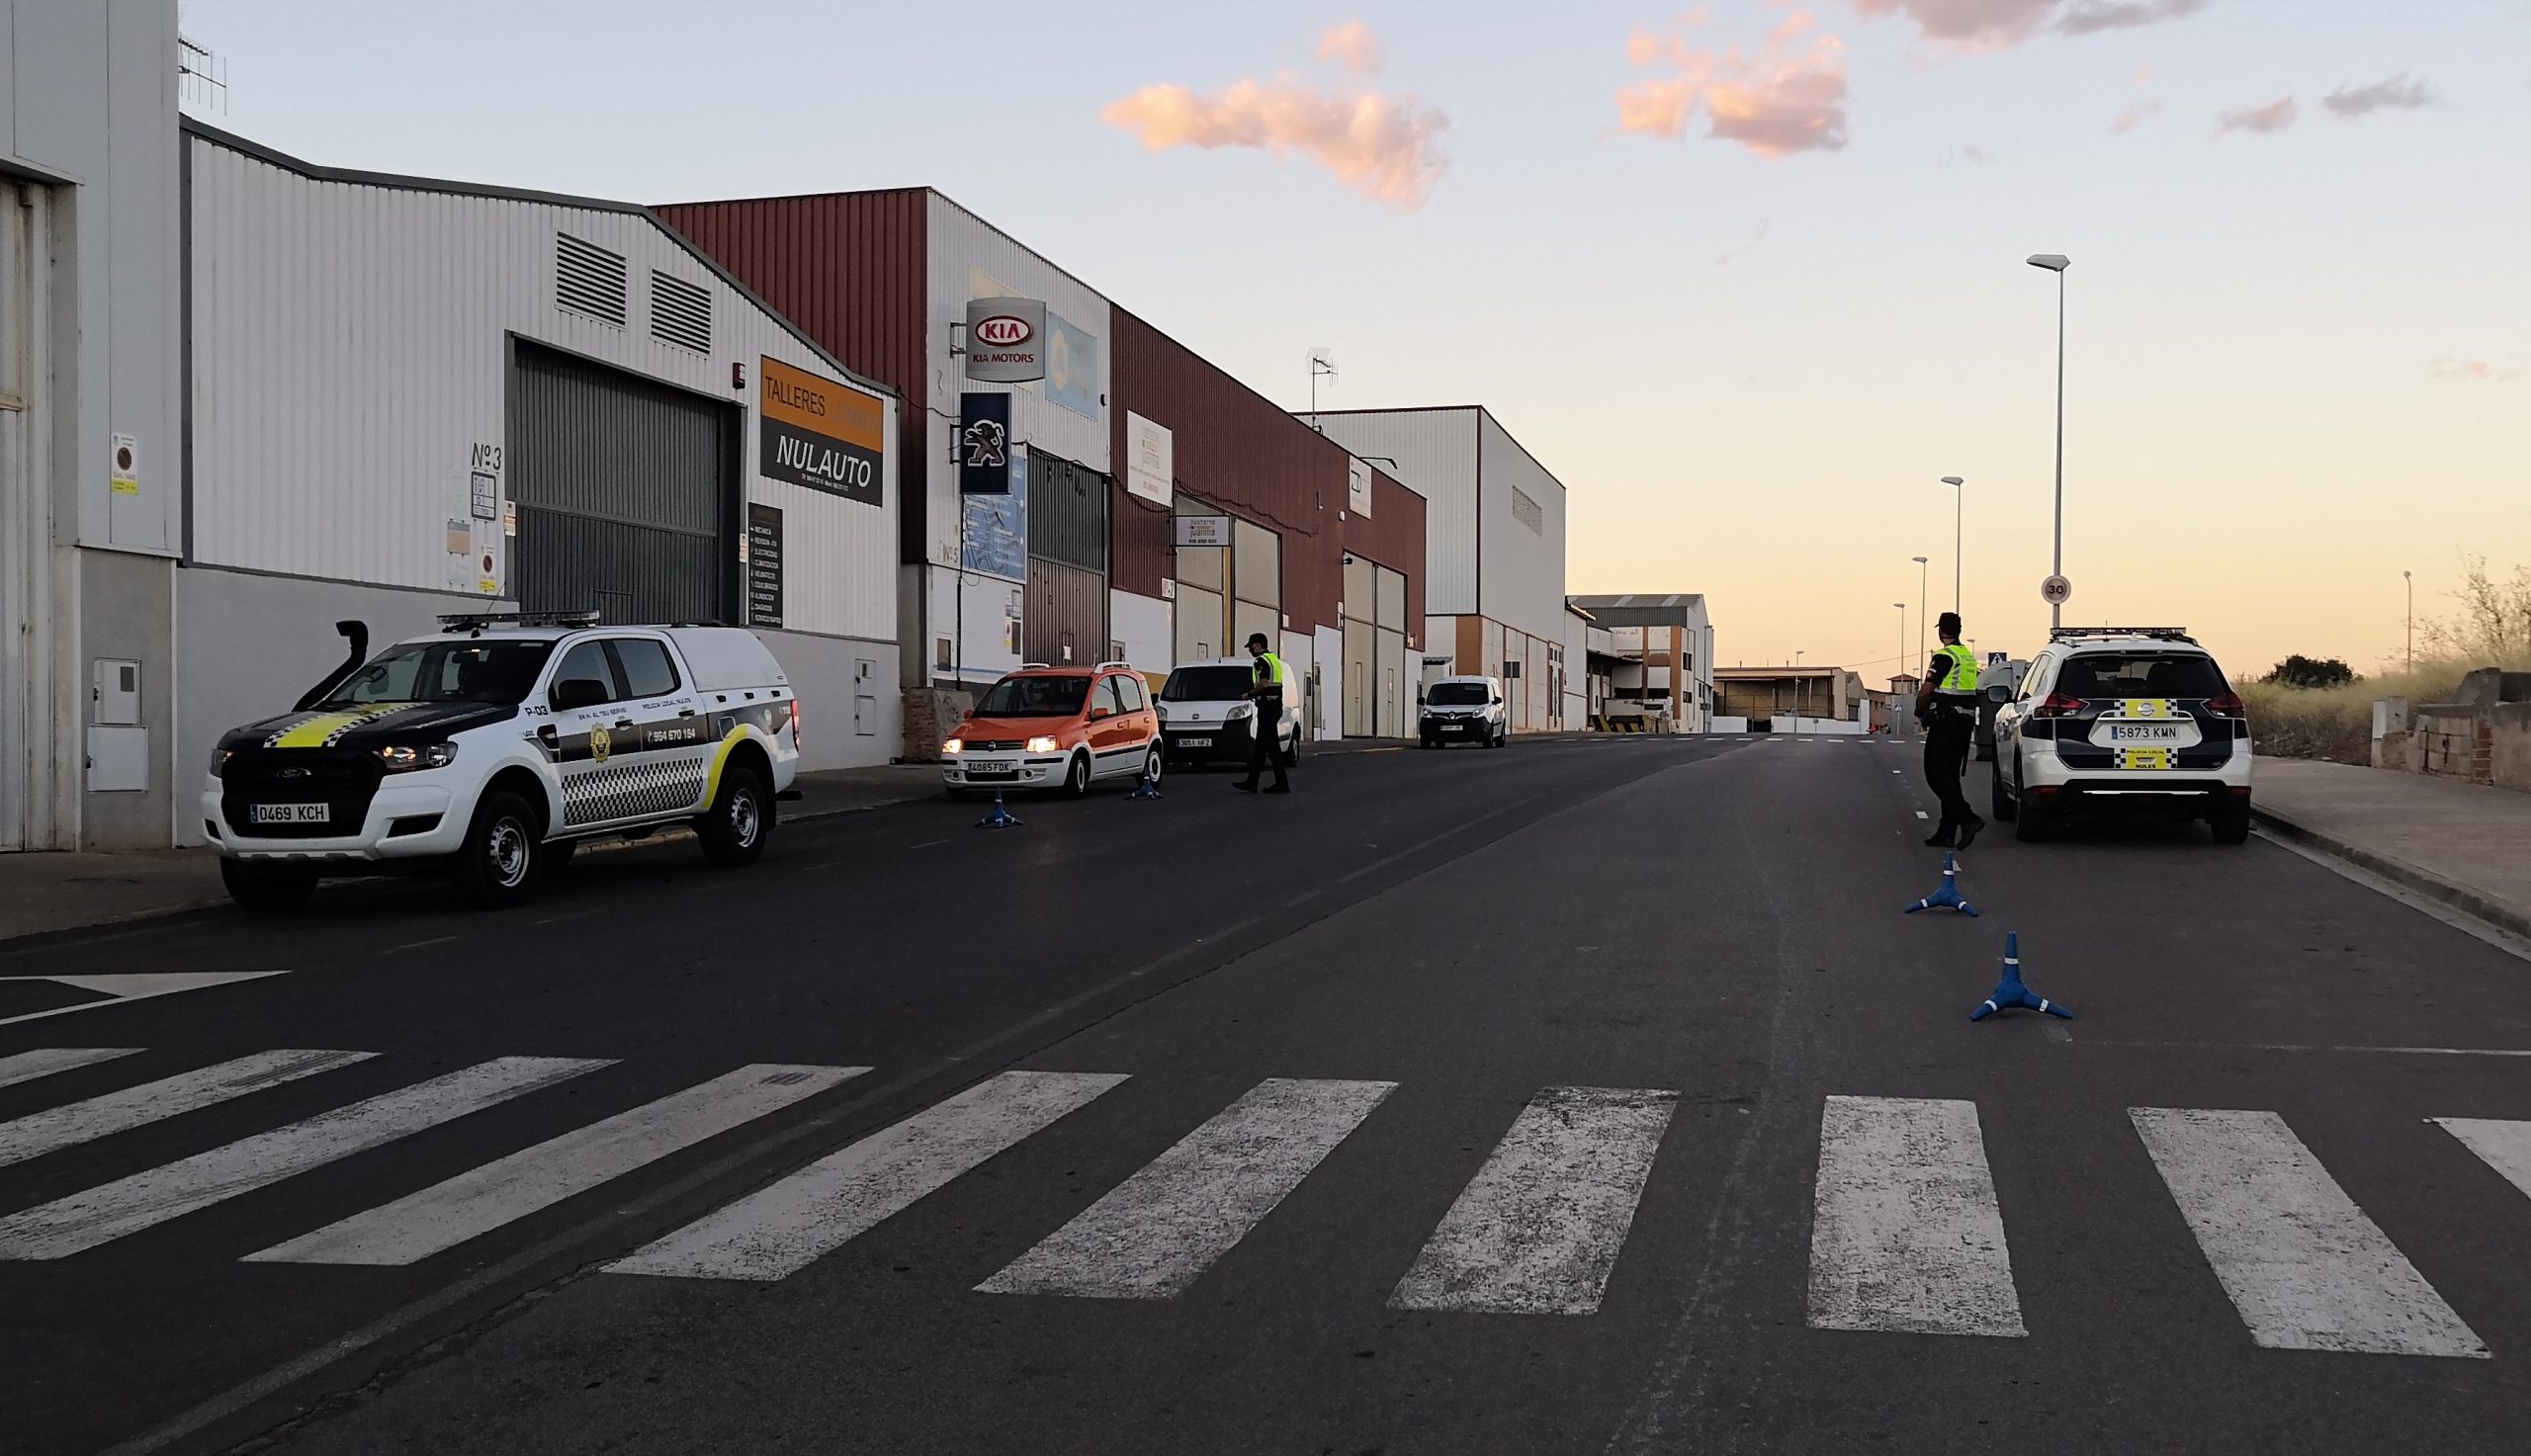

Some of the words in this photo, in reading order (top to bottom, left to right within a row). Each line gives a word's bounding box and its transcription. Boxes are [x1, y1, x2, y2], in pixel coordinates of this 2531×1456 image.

[985, 323, 1020, 339] KIA
[972, 354, 989, 363] KIA
[992, 353, 1034, 363] MOTORS
[765, 376, 826, 417] TALLERES
[776, 435, 871, 487] NULAUTO
[2048, 585, 2064, 595] 30
[524, 705, 548, 716] P-03
[2119, 727, 2149, 738] 5873
[2153, 727, 2176, 738] KMN
[993, 762, 1009, 771] FDK
[259, 806, 292, 821] 0469
[298, 806, 324, 820] KCH
